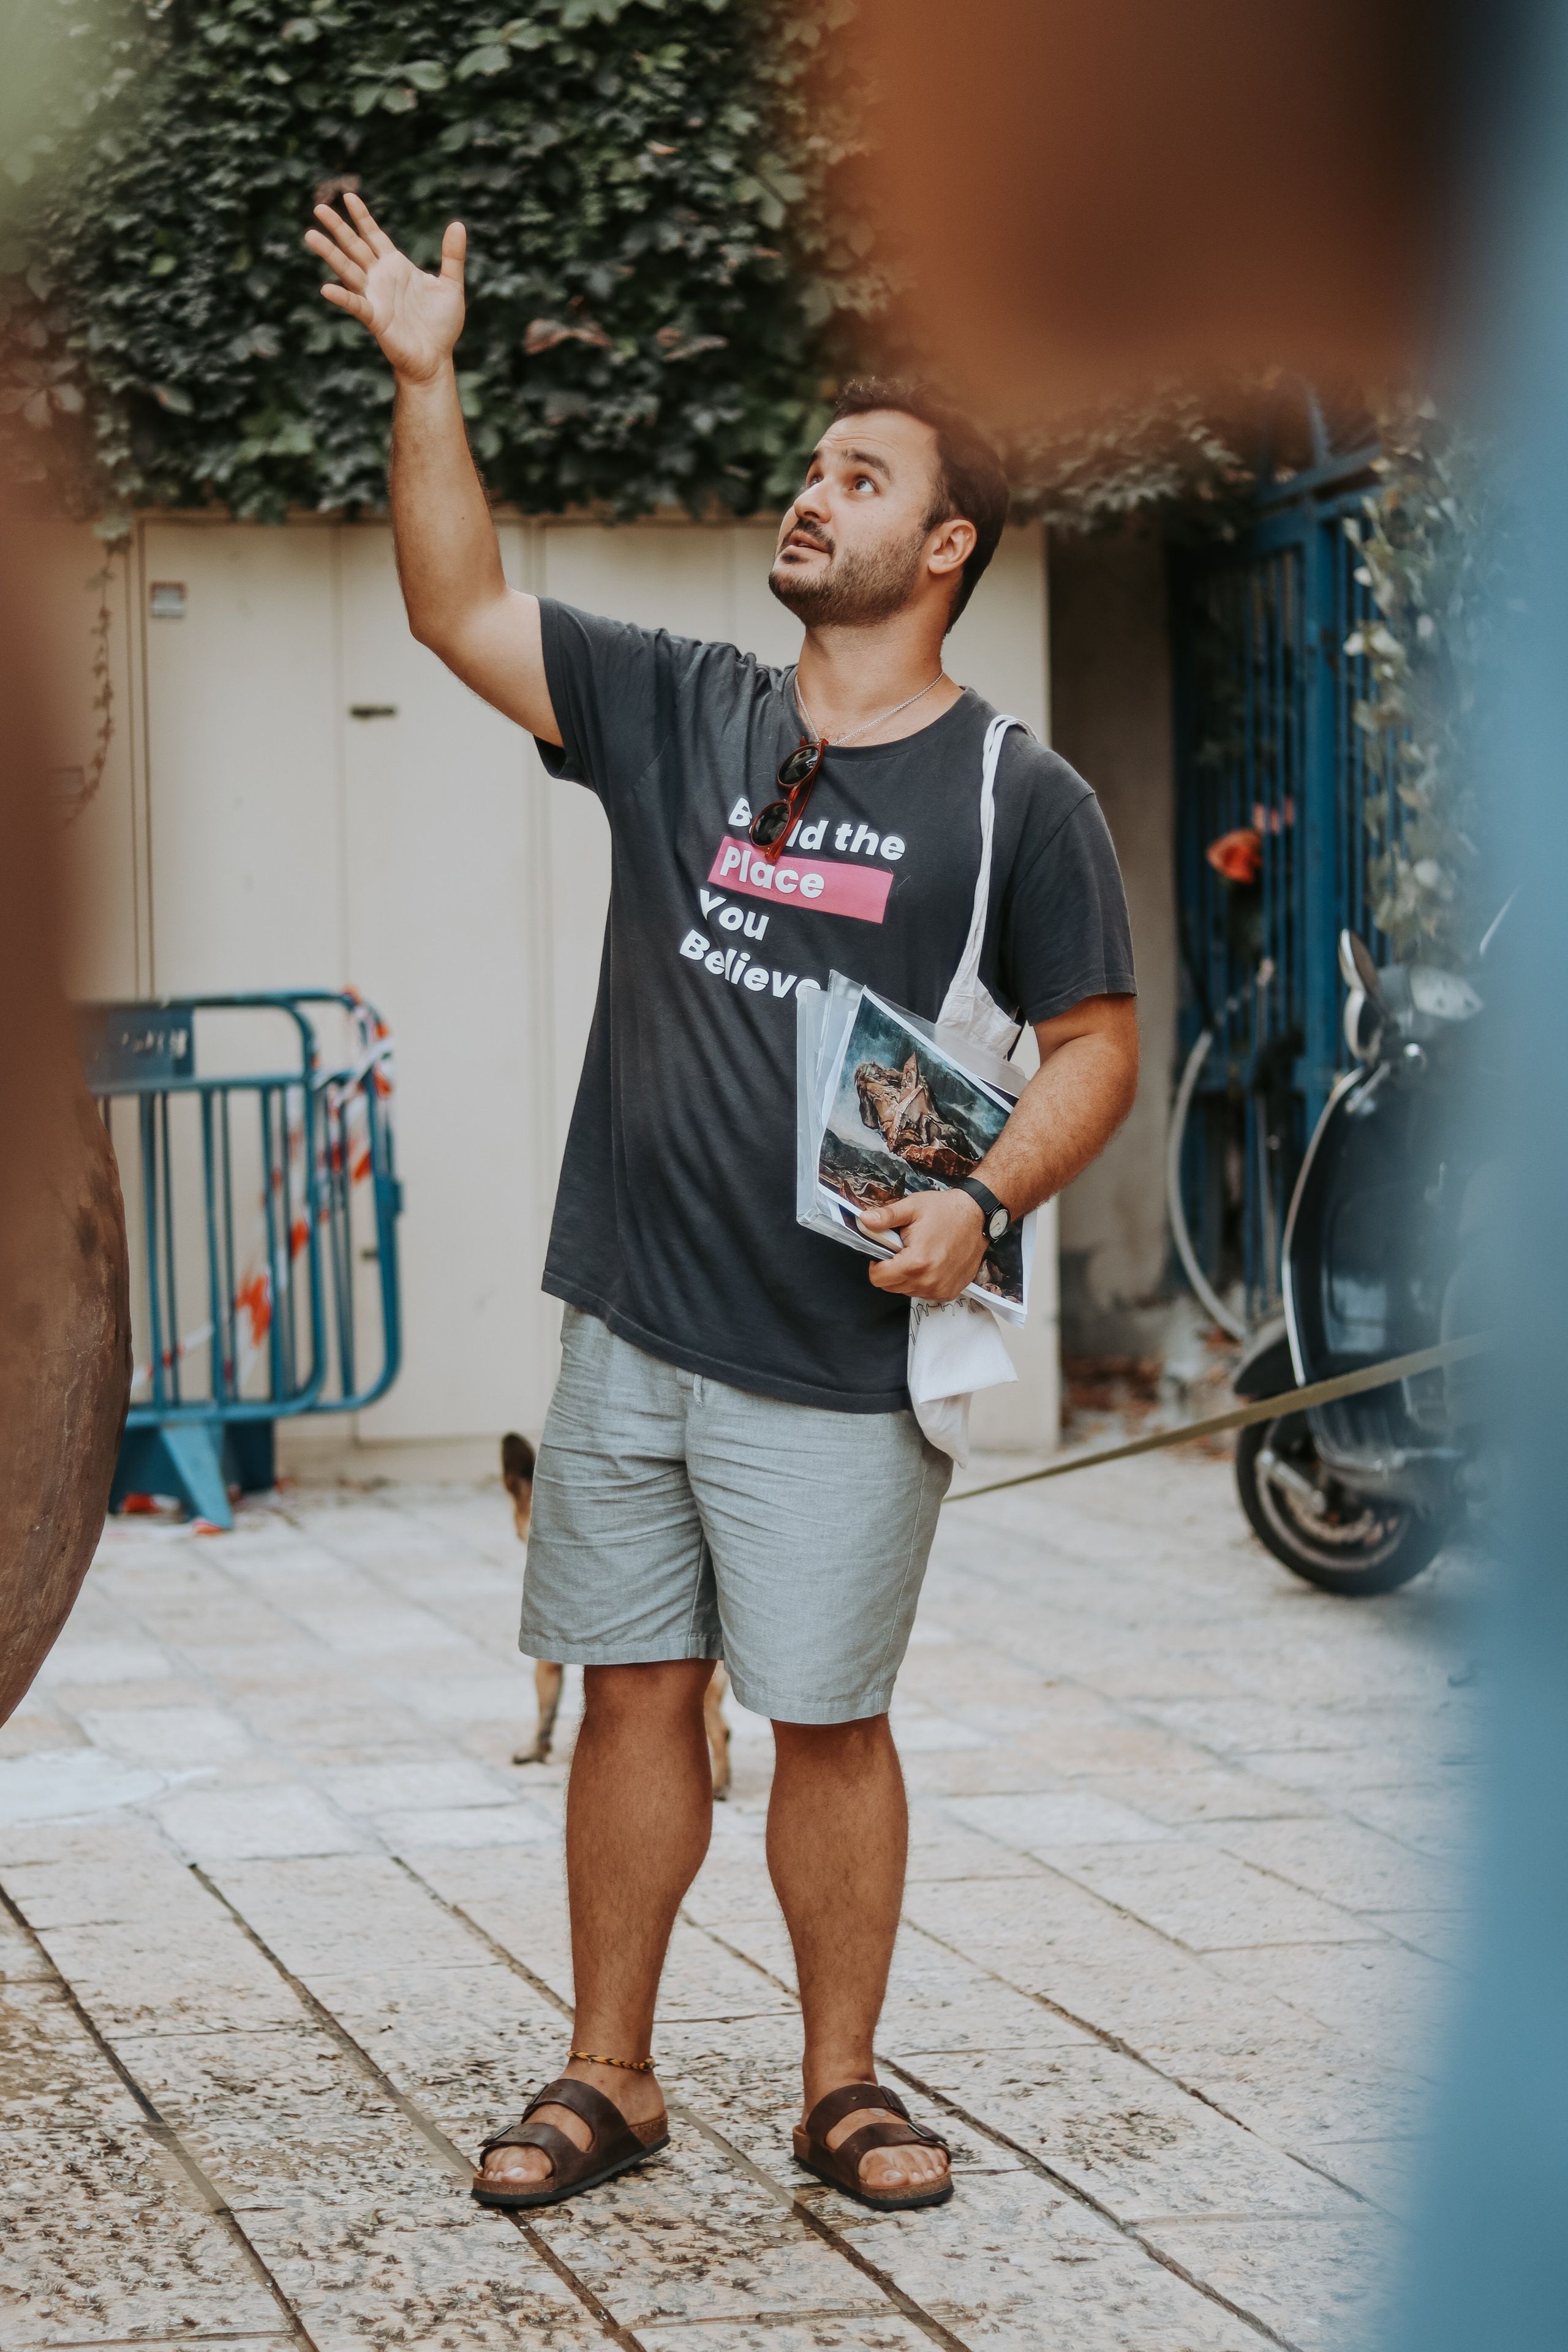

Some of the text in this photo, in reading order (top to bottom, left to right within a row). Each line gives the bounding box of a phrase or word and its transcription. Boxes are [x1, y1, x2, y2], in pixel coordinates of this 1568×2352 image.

[728, 797, 905, 861] Bld the
[719, 846, 825, 899] Place
[699, 889, 770, 941] You
